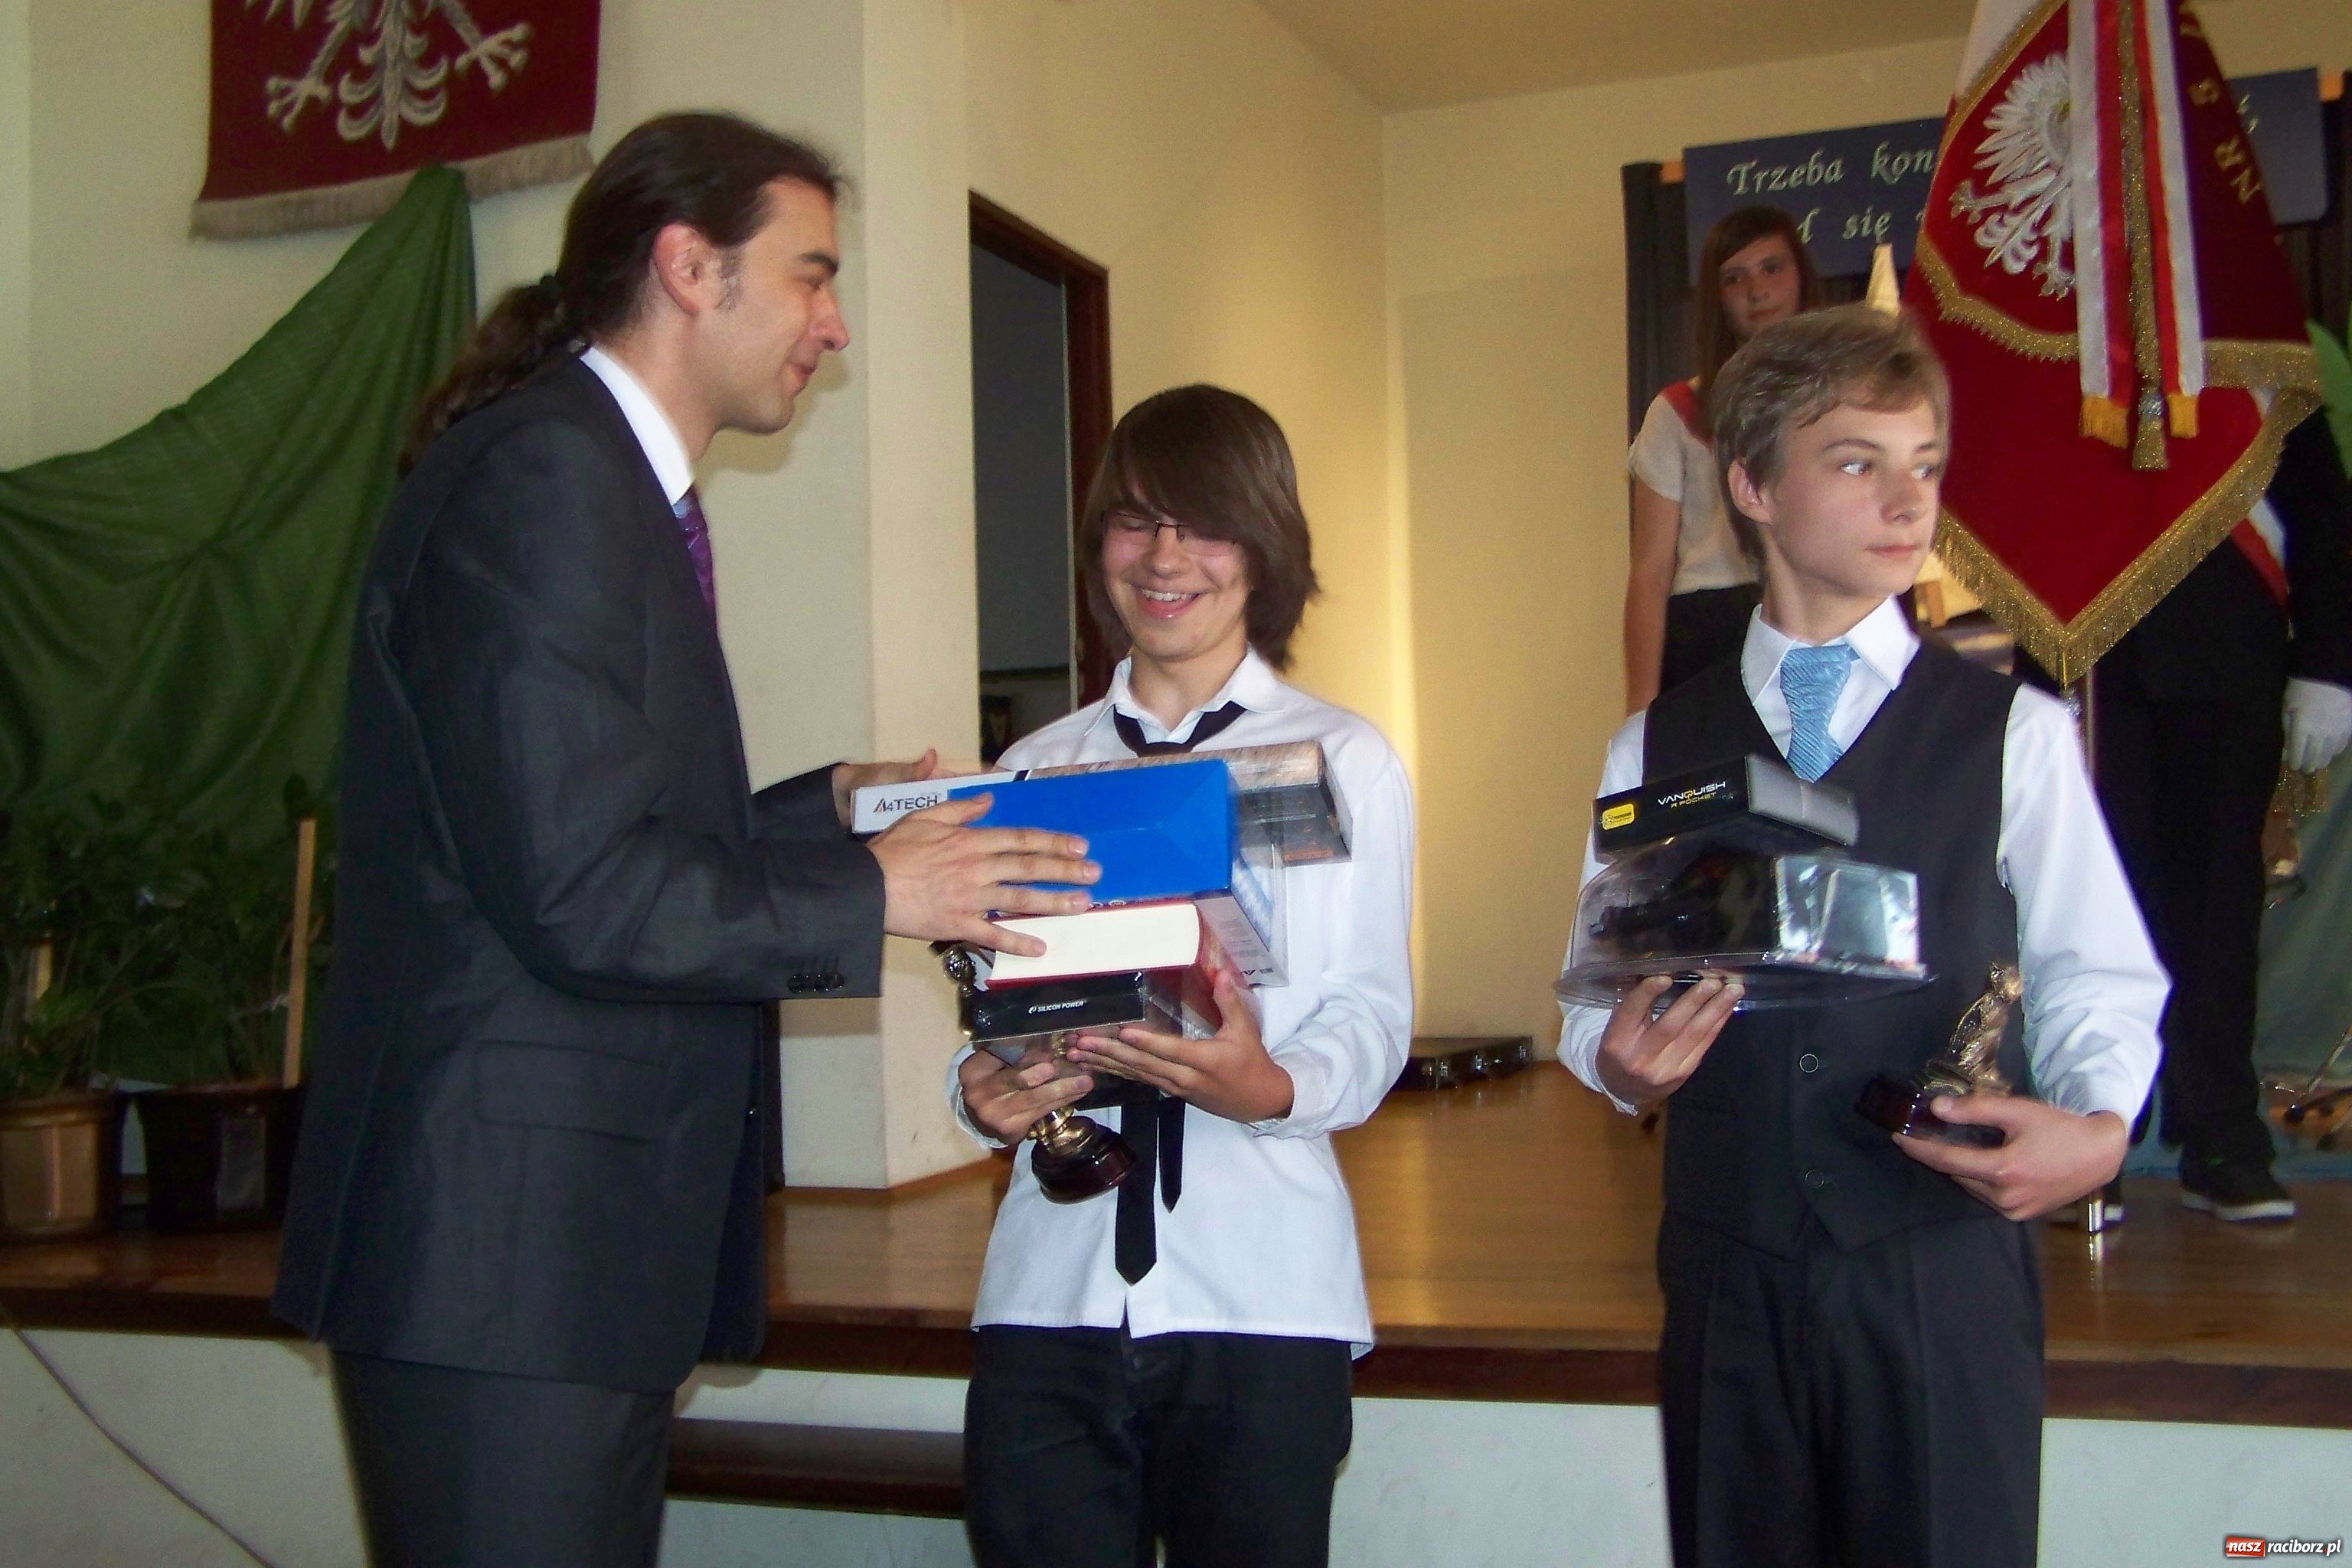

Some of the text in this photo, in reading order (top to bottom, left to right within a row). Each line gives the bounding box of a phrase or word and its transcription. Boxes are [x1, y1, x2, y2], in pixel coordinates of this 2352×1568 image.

[1726, 148, 1844, 195] Trzeba
[1841, 205, 1892, 243] się
[1657, 781, 1726, 805] VANQUISH
[1679, 792, 1717, 806] POCKET
[873, 795, 938, 813] A4TECH
[1037, 1000, 1084, 1013] SILICON POWER
